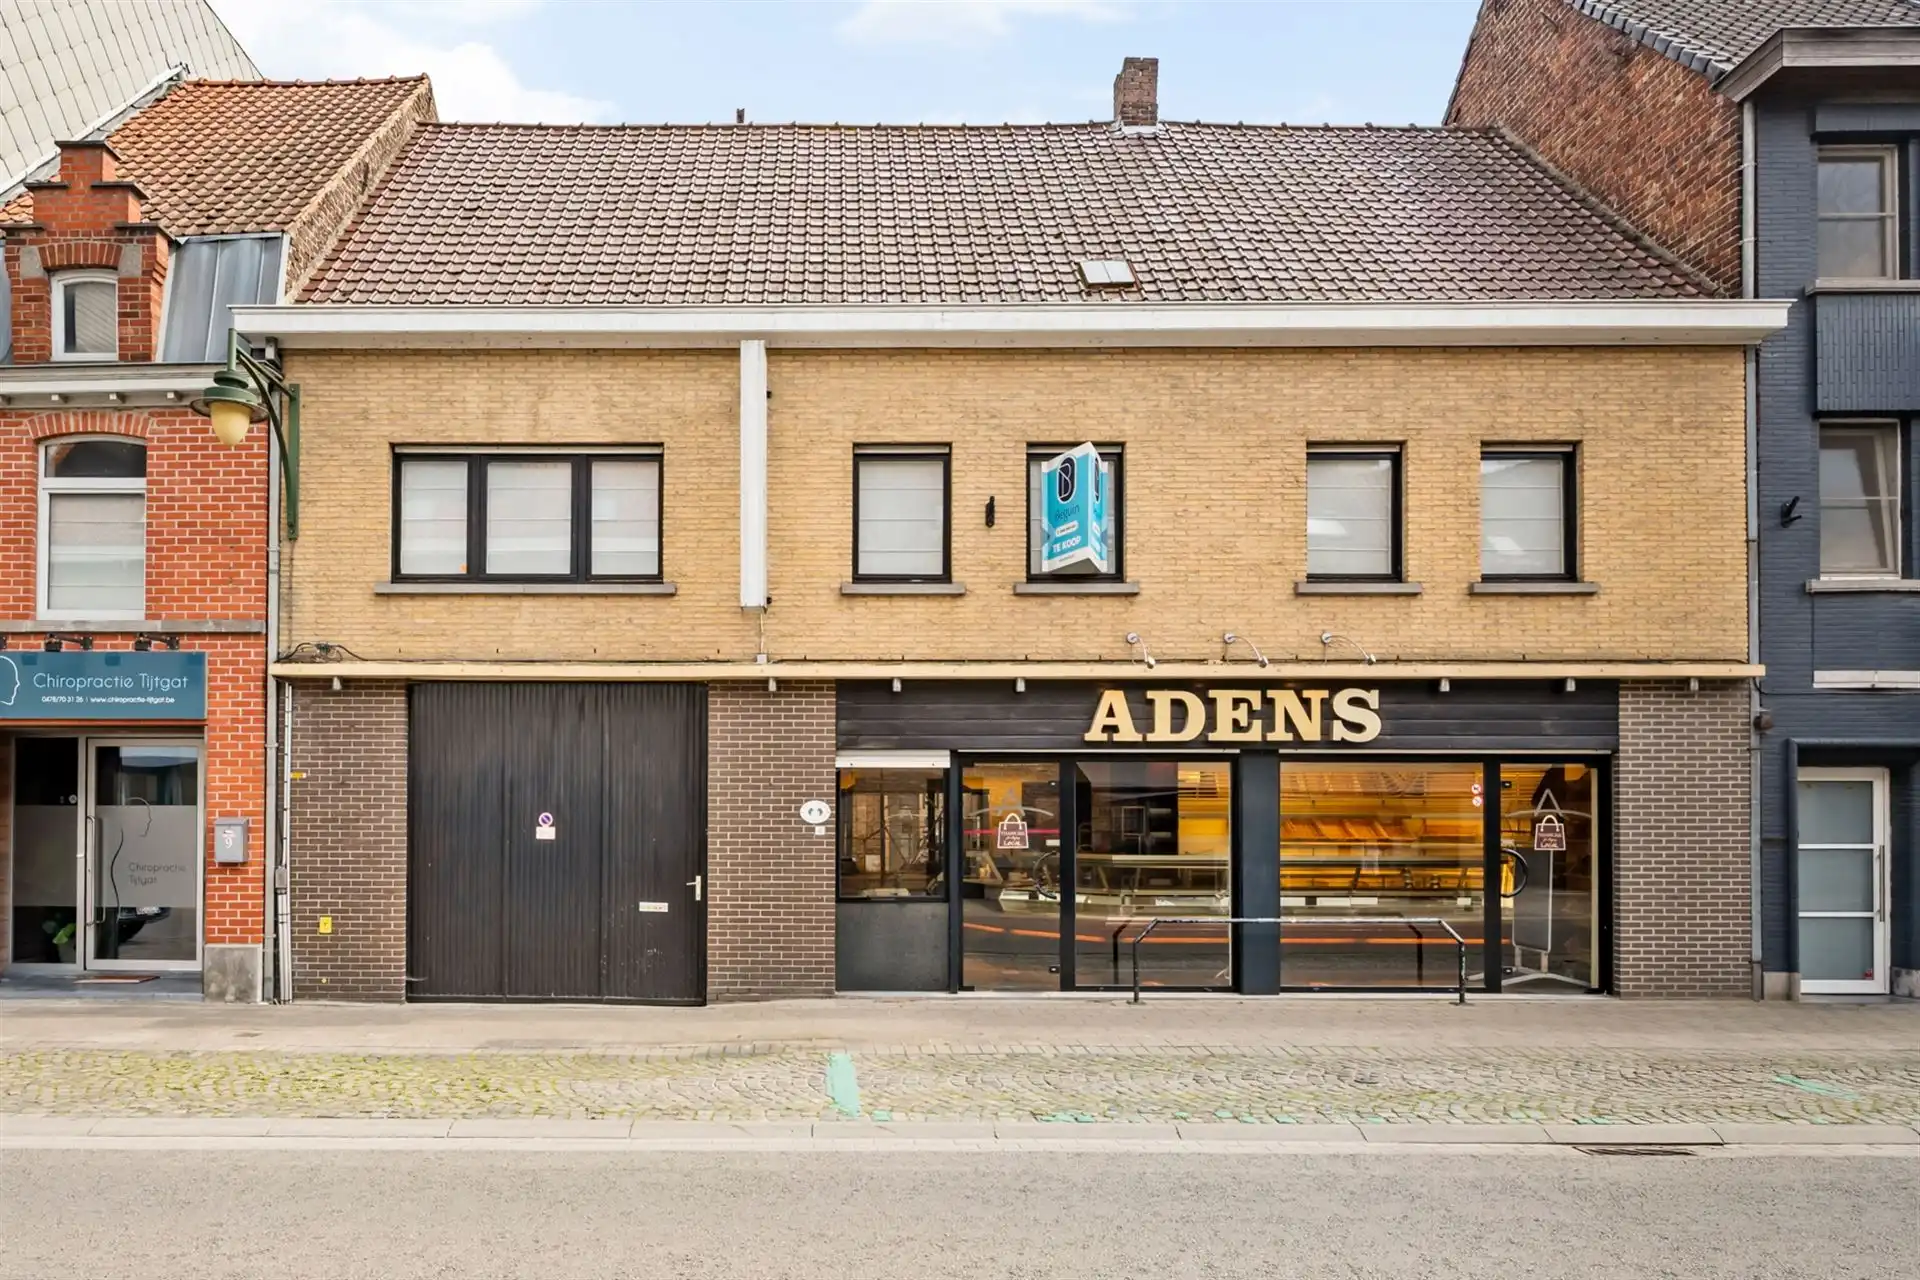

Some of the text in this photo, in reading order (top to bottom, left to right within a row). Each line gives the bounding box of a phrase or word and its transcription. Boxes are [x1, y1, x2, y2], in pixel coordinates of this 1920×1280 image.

[1062, 535, 1081, 549] KOOP
[33, 672, 188, 692] Chiropractie Tijtgat
[1084, 688, 1382, 743] ADENS
